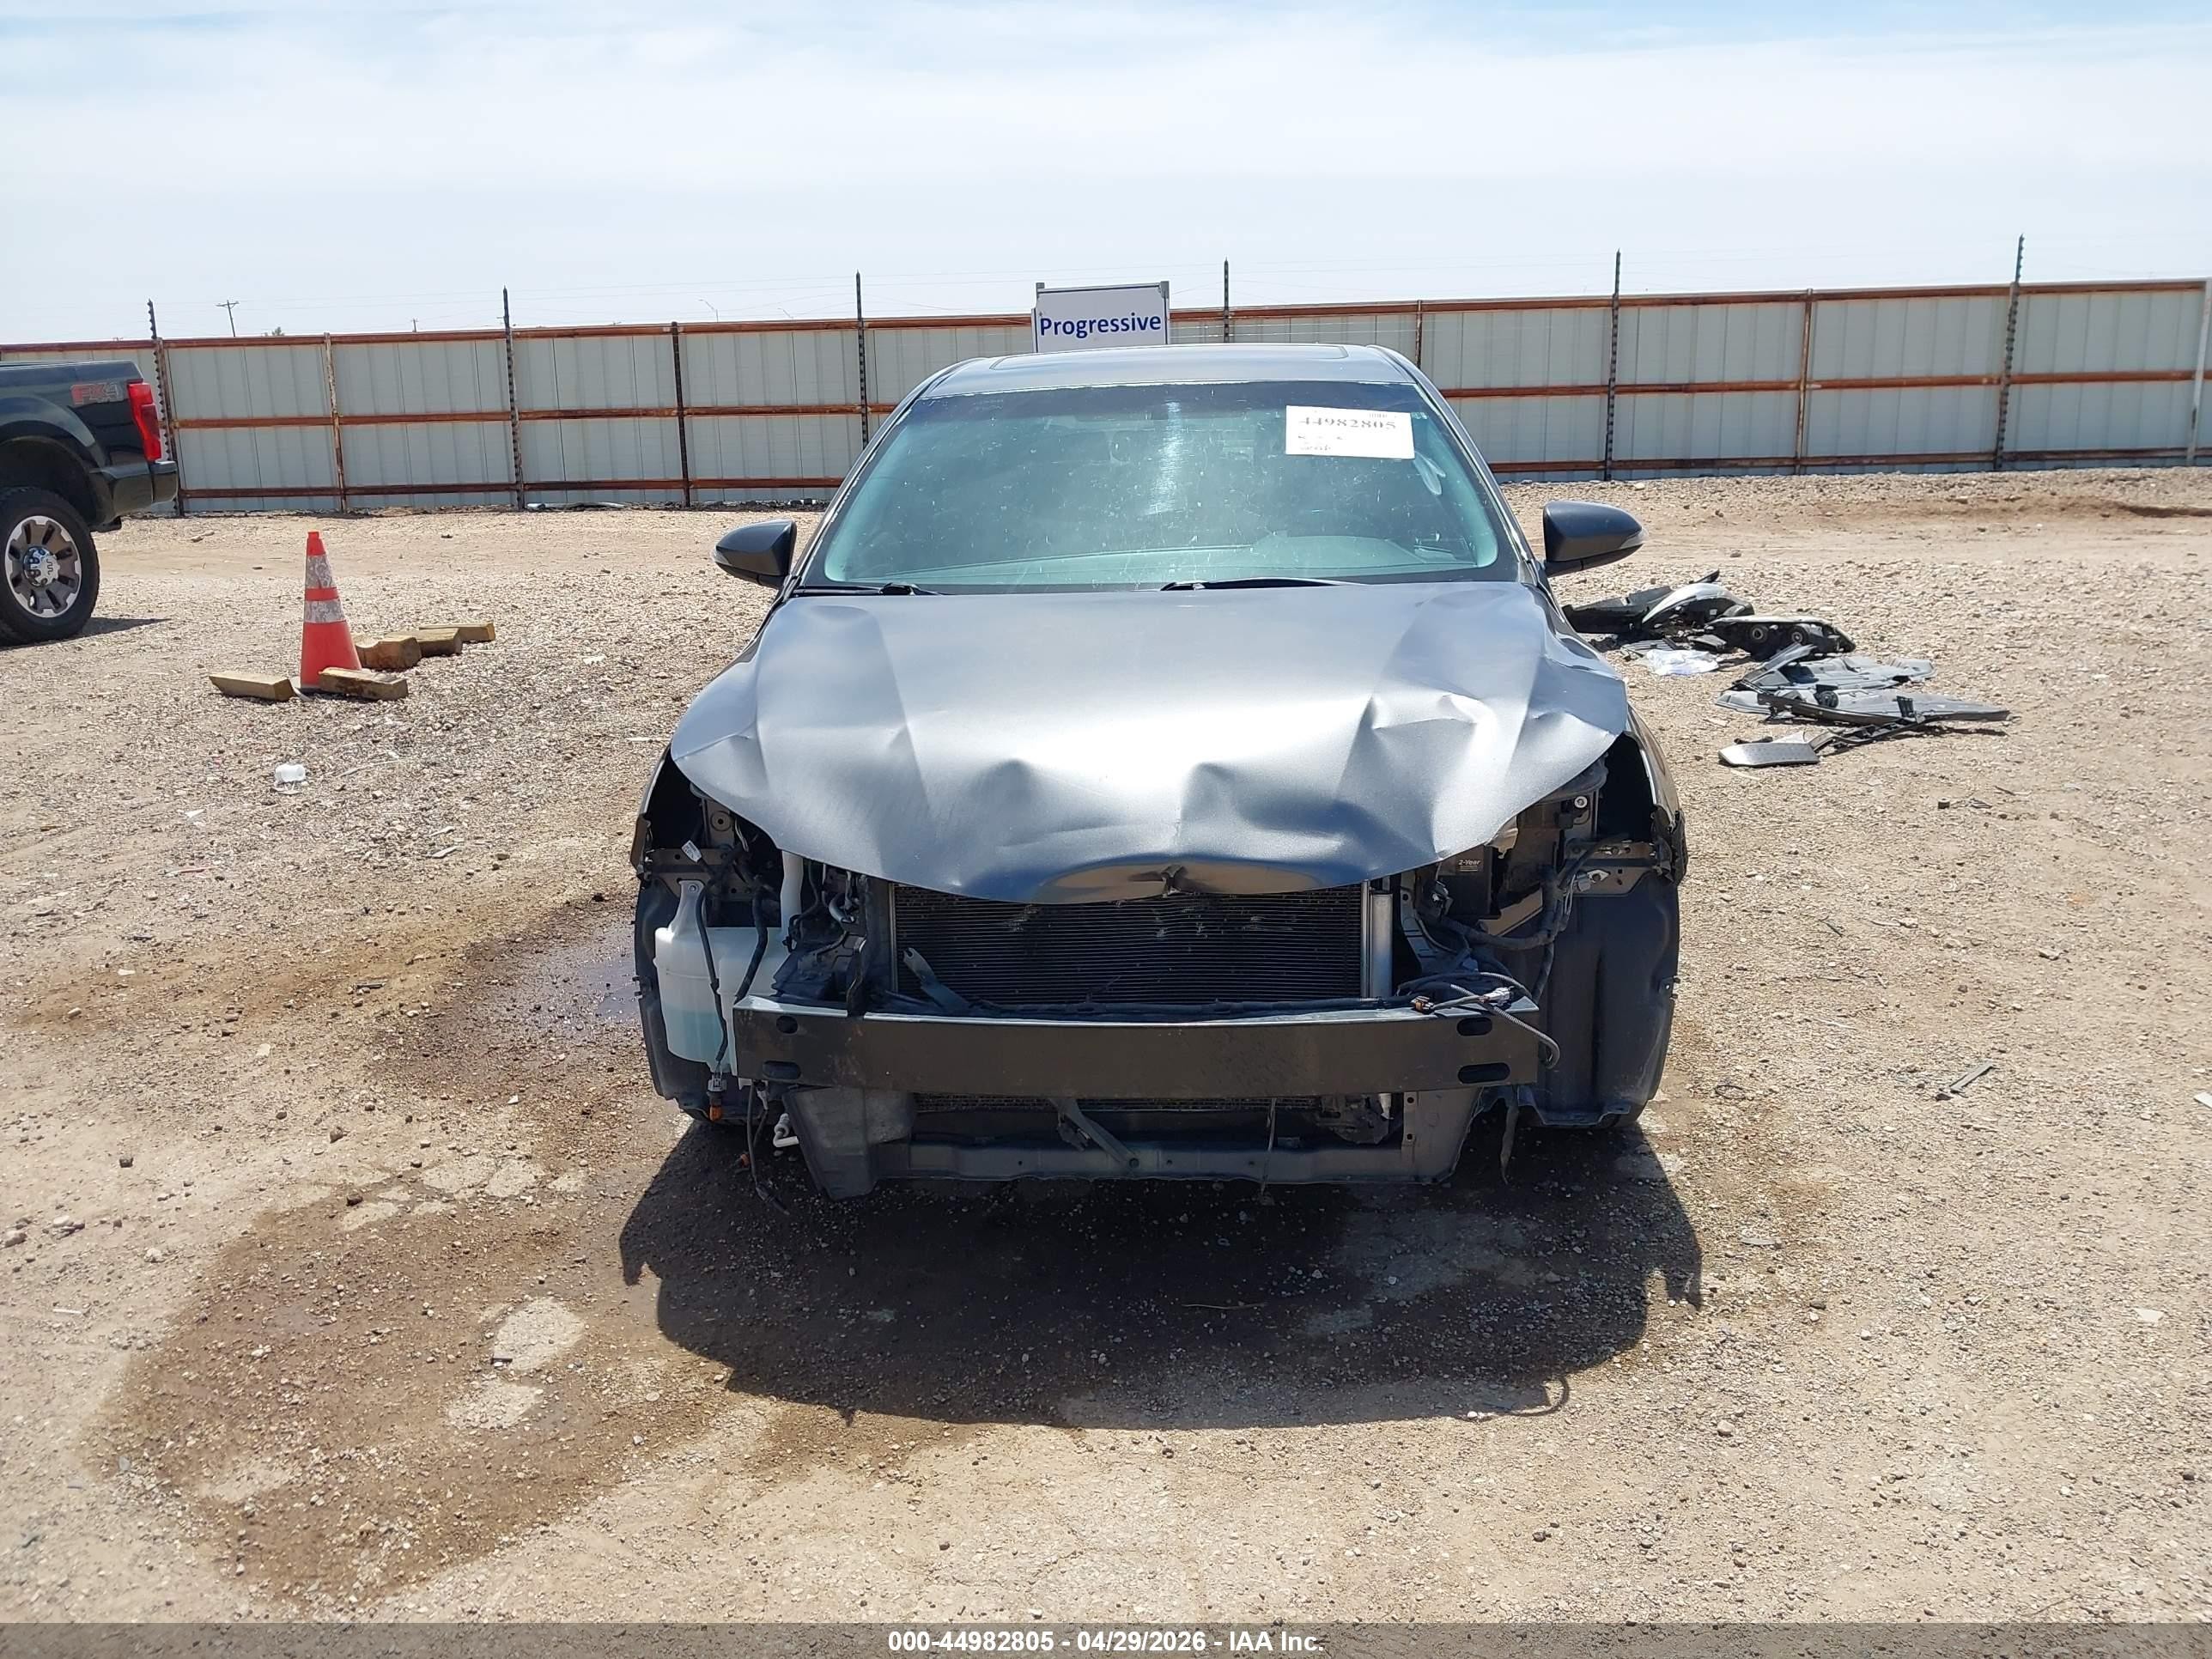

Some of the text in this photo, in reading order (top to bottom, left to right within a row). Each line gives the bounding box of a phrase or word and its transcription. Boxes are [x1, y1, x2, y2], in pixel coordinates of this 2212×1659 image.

[1040, 312, 1162, 339] Progressive
[71, 382, 124, 405] FX4
[1297, 416, 1397, 430] 44982805
